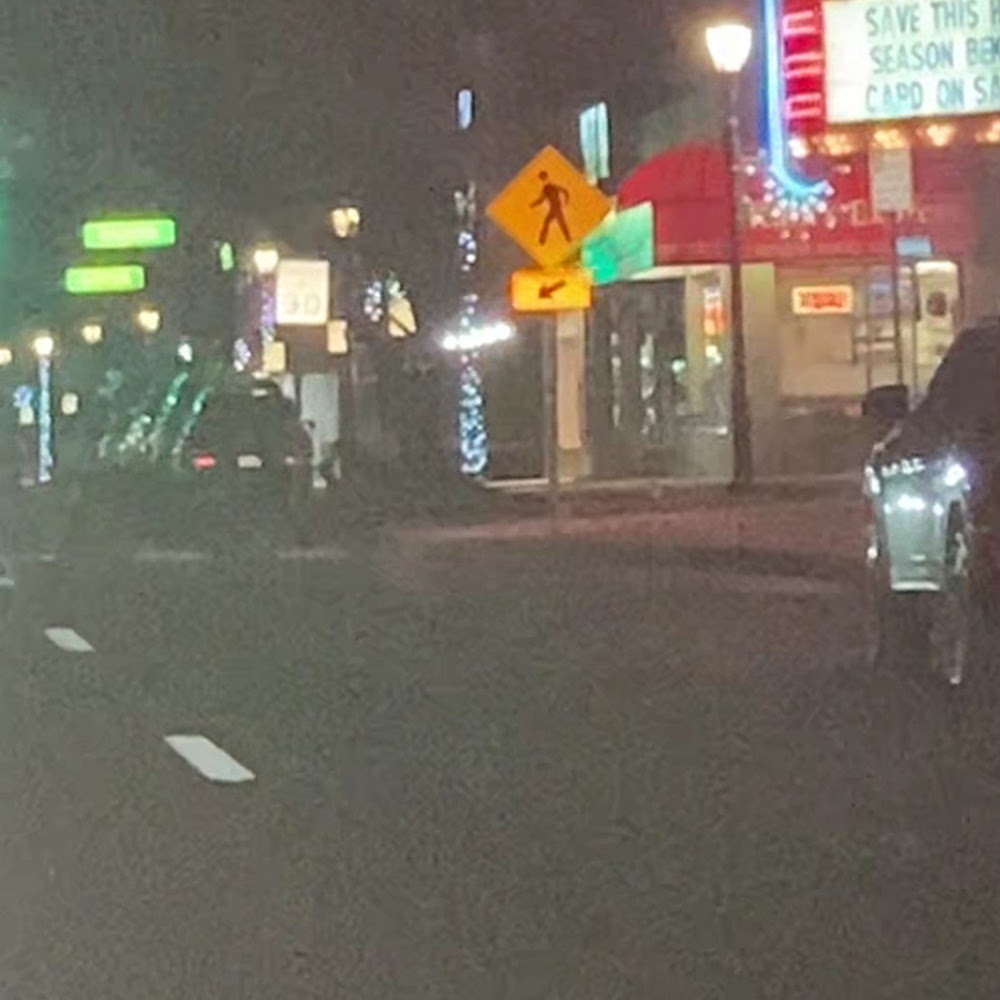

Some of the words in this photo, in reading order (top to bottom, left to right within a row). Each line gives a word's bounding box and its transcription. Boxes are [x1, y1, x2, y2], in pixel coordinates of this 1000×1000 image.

[865, 3, 921, 37] SAVE
[869, 42, 954, 74] SEASON
[936, 78, 964, 107] ON
